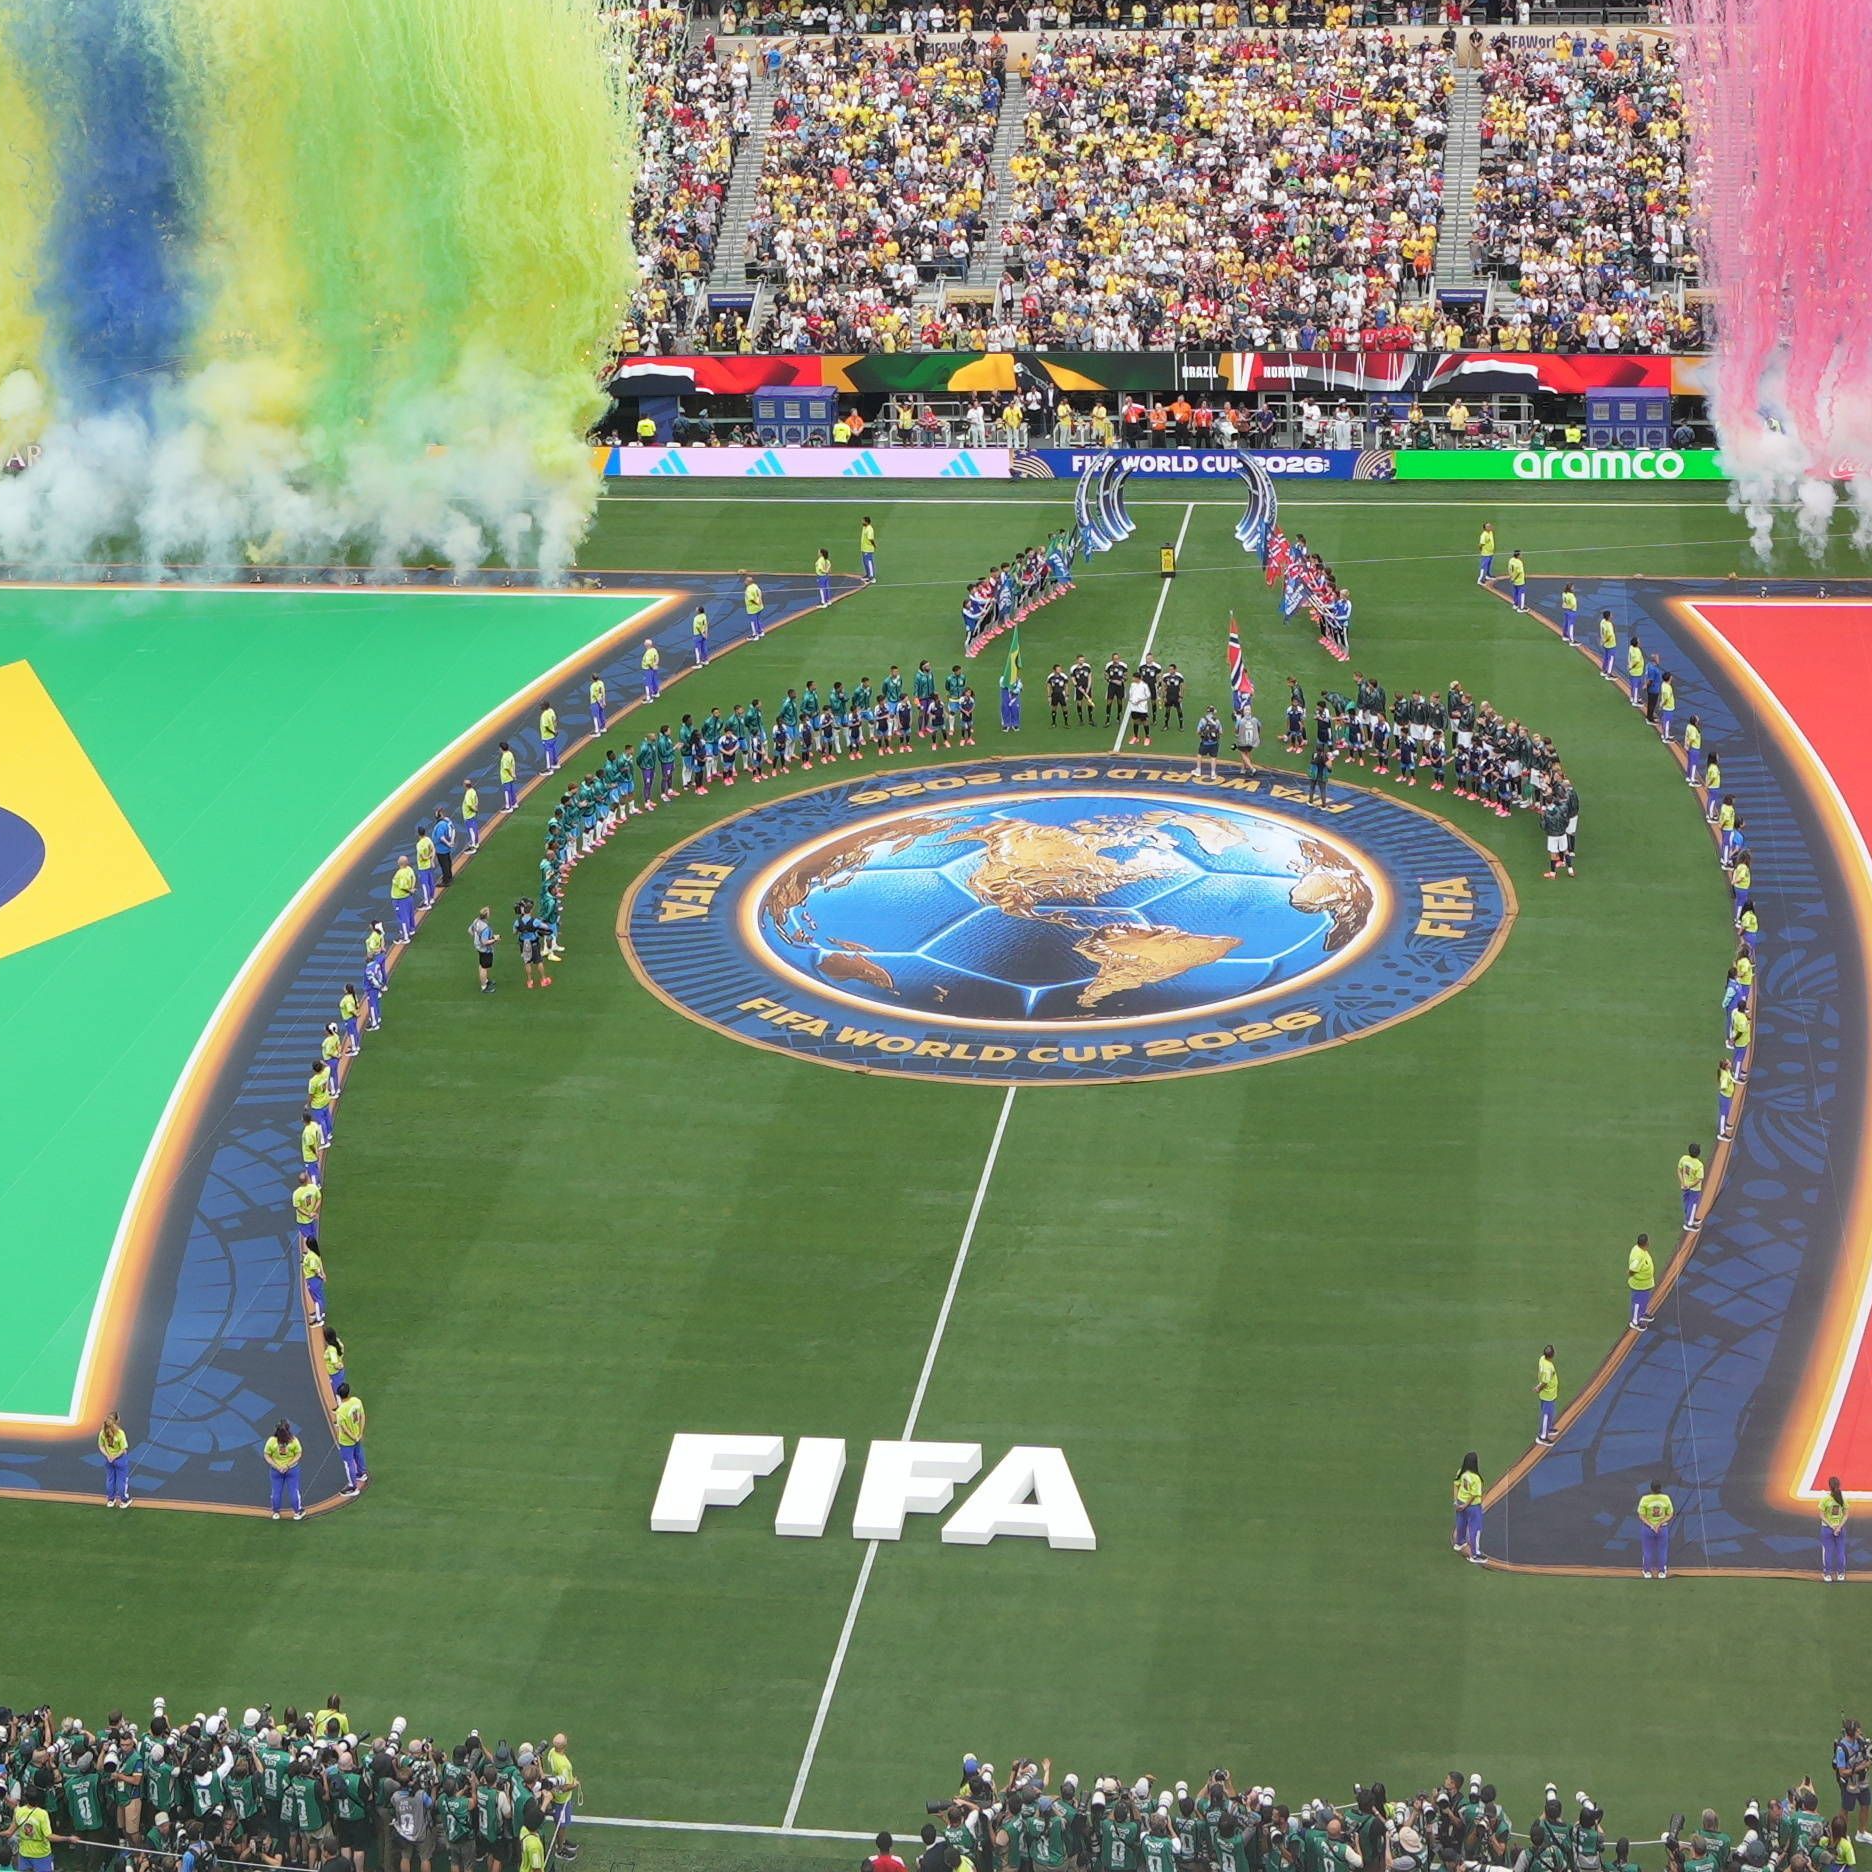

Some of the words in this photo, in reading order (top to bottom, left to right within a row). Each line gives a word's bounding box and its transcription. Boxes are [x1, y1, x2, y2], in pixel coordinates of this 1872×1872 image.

[1181, 365, 1219, 378] BRAZIL
[1232, 352, 1255, 391] V
[1263, 365, 1309, 378] NORWAY
[1121, 455, 1198, 473] WORLD
[1512, 450, 1685, 479] aramco
[847, 771, 1004, 806] 2026
[1011, 767, 1099, 781] CUP
[658, 863, 735, 923] FIFA
[1414, 876, 1473, 939] FIFA
[736, 998, 826, 1038] FIFA
[835, 1026, 1017, 1063] WORLD
[1027, 1044, 1133, 1063] CUP
[1145, 1012, 1323, 1057] 2026
[650, 1432, 1097, 1550] FIFA
